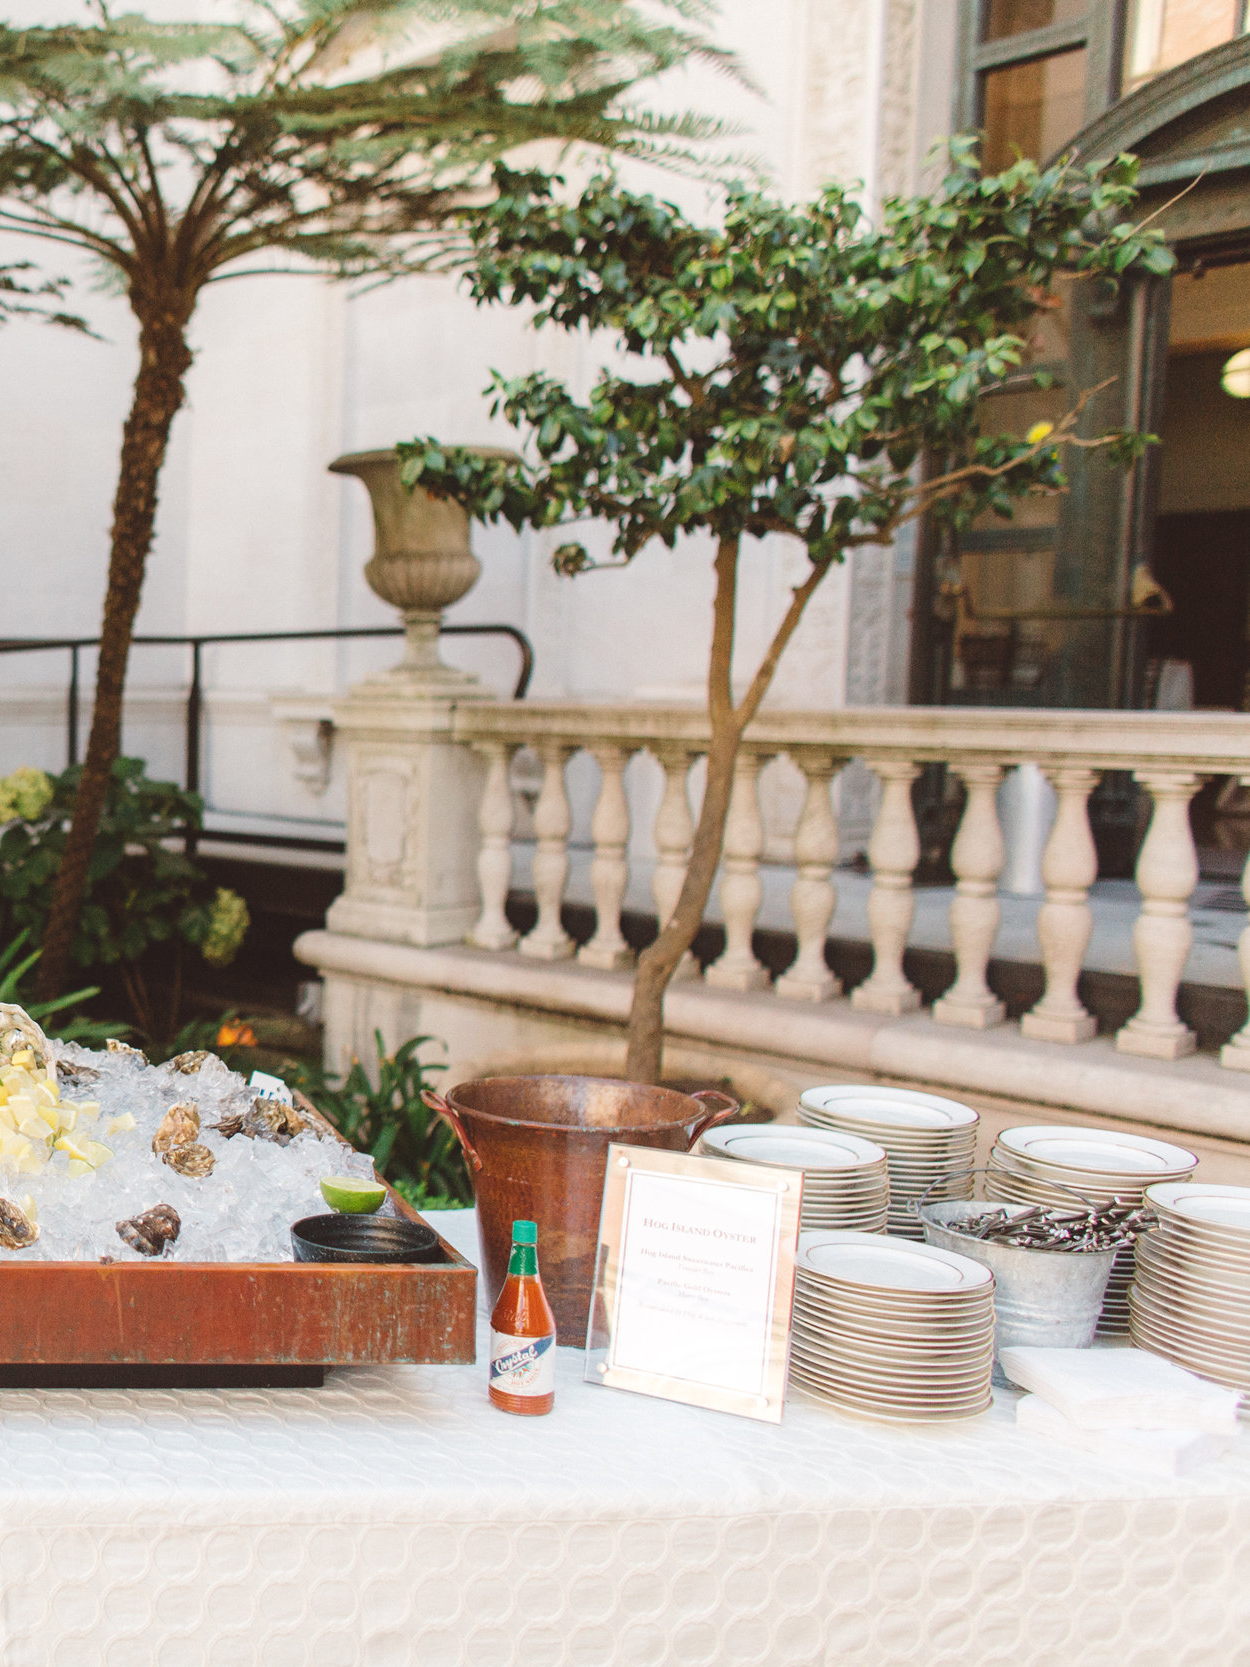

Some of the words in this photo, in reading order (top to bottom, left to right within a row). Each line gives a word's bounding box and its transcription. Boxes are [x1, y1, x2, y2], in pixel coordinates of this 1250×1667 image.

[643, 1217, 669, 1230] HOG
[671, 1222, 711, 1237] ISLAND
[712, 1228, 756, 1244] OYSTER
[496, 1345, 538, 1375] Crystal
